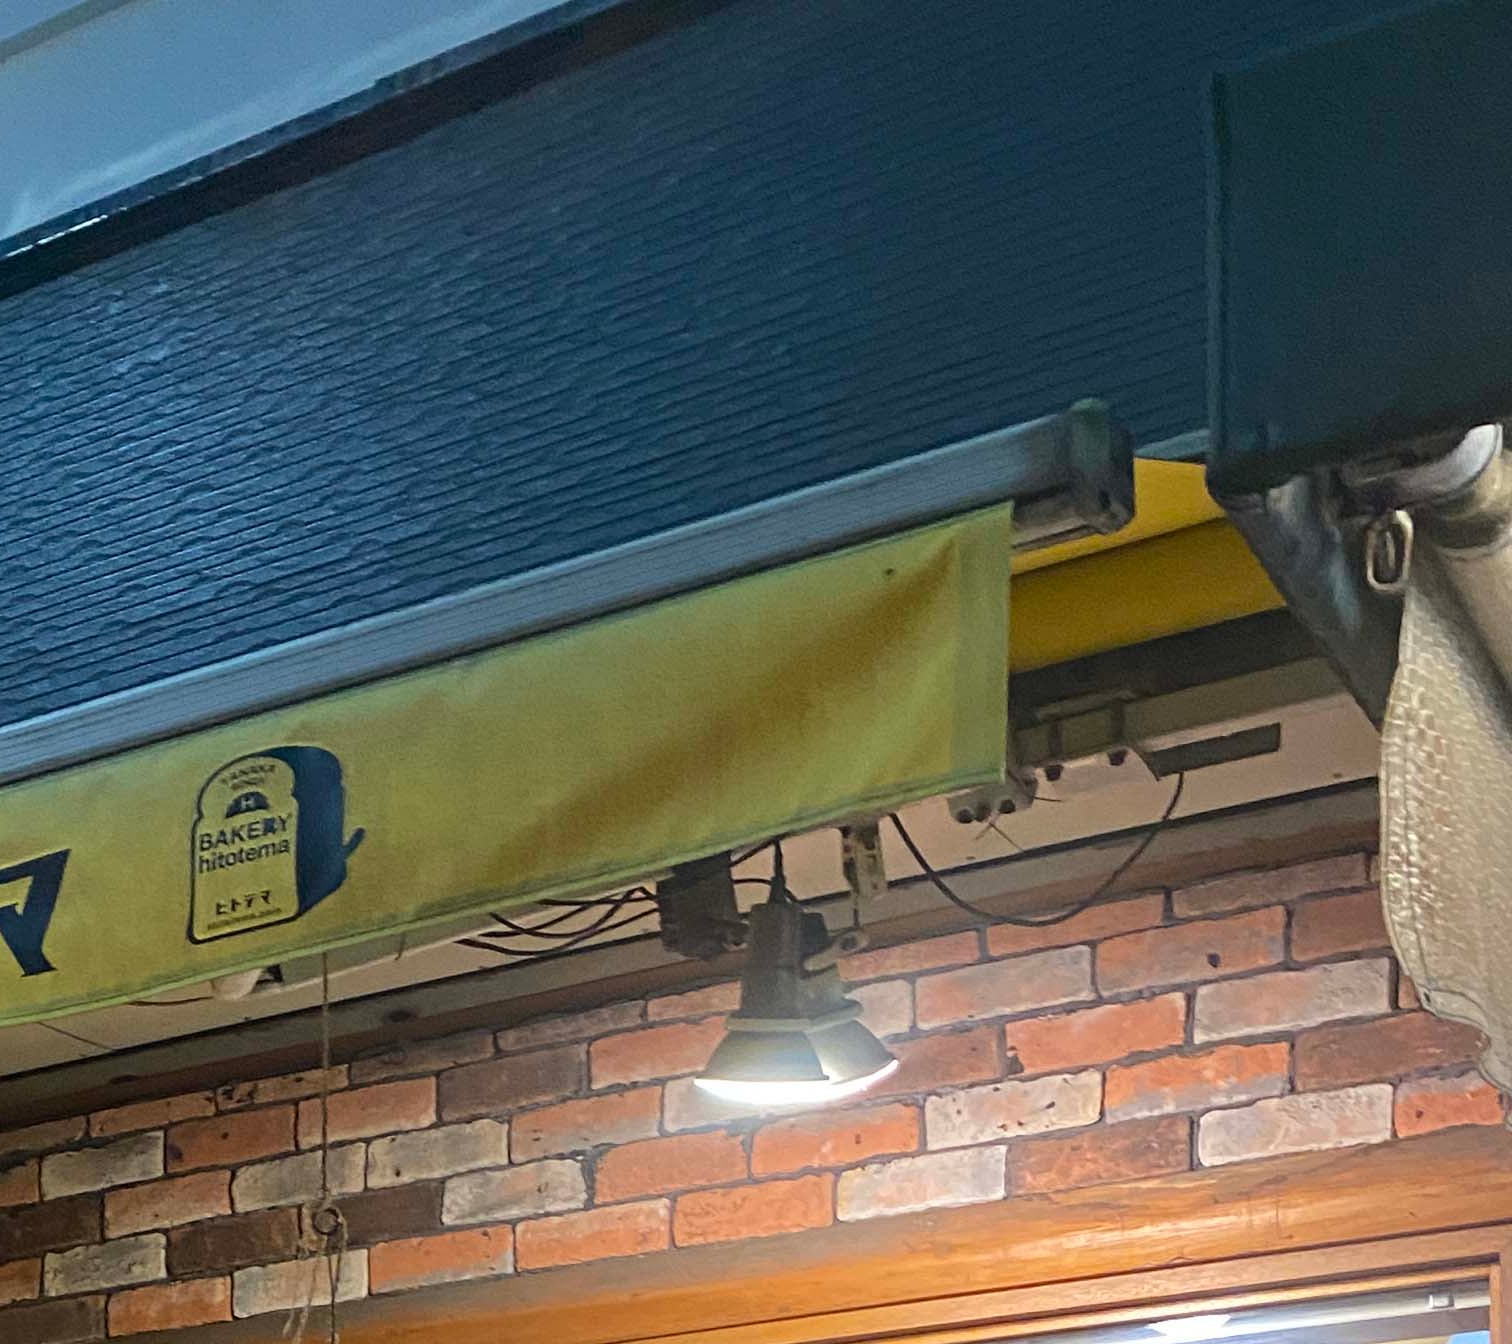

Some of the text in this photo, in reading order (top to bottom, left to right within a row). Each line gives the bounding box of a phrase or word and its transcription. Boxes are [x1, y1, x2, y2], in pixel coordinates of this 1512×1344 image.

[199, 814, 292, 852] BAKERY
[199, 838, 291, 874] hitotema
[215, 889, 272, 915] ヒトテマ
